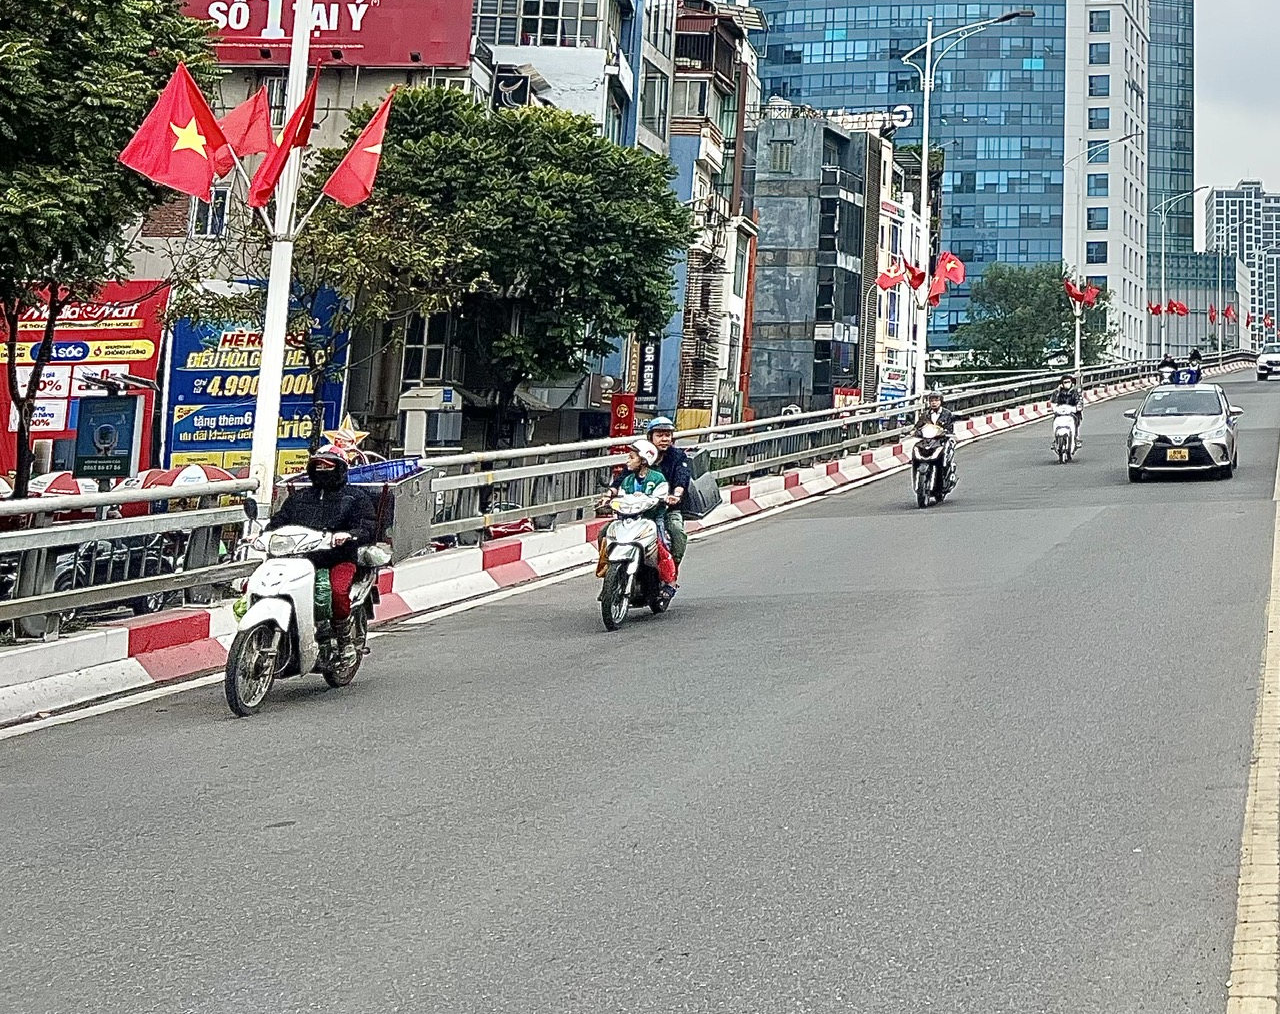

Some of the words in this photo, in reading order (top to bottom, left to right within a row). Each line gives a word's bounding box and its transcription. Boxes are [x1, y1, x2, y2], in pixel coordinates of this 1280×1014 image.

[292, 2, 339, 37] ẠI
[187, 347, 219, 368] ĐIỀU
[220, 348, 249, 367] HÒA
[642, 365, 655, 393] RENT
[193, 415, 217, 429] tặng
[218, 414, 244, 426] thêm
